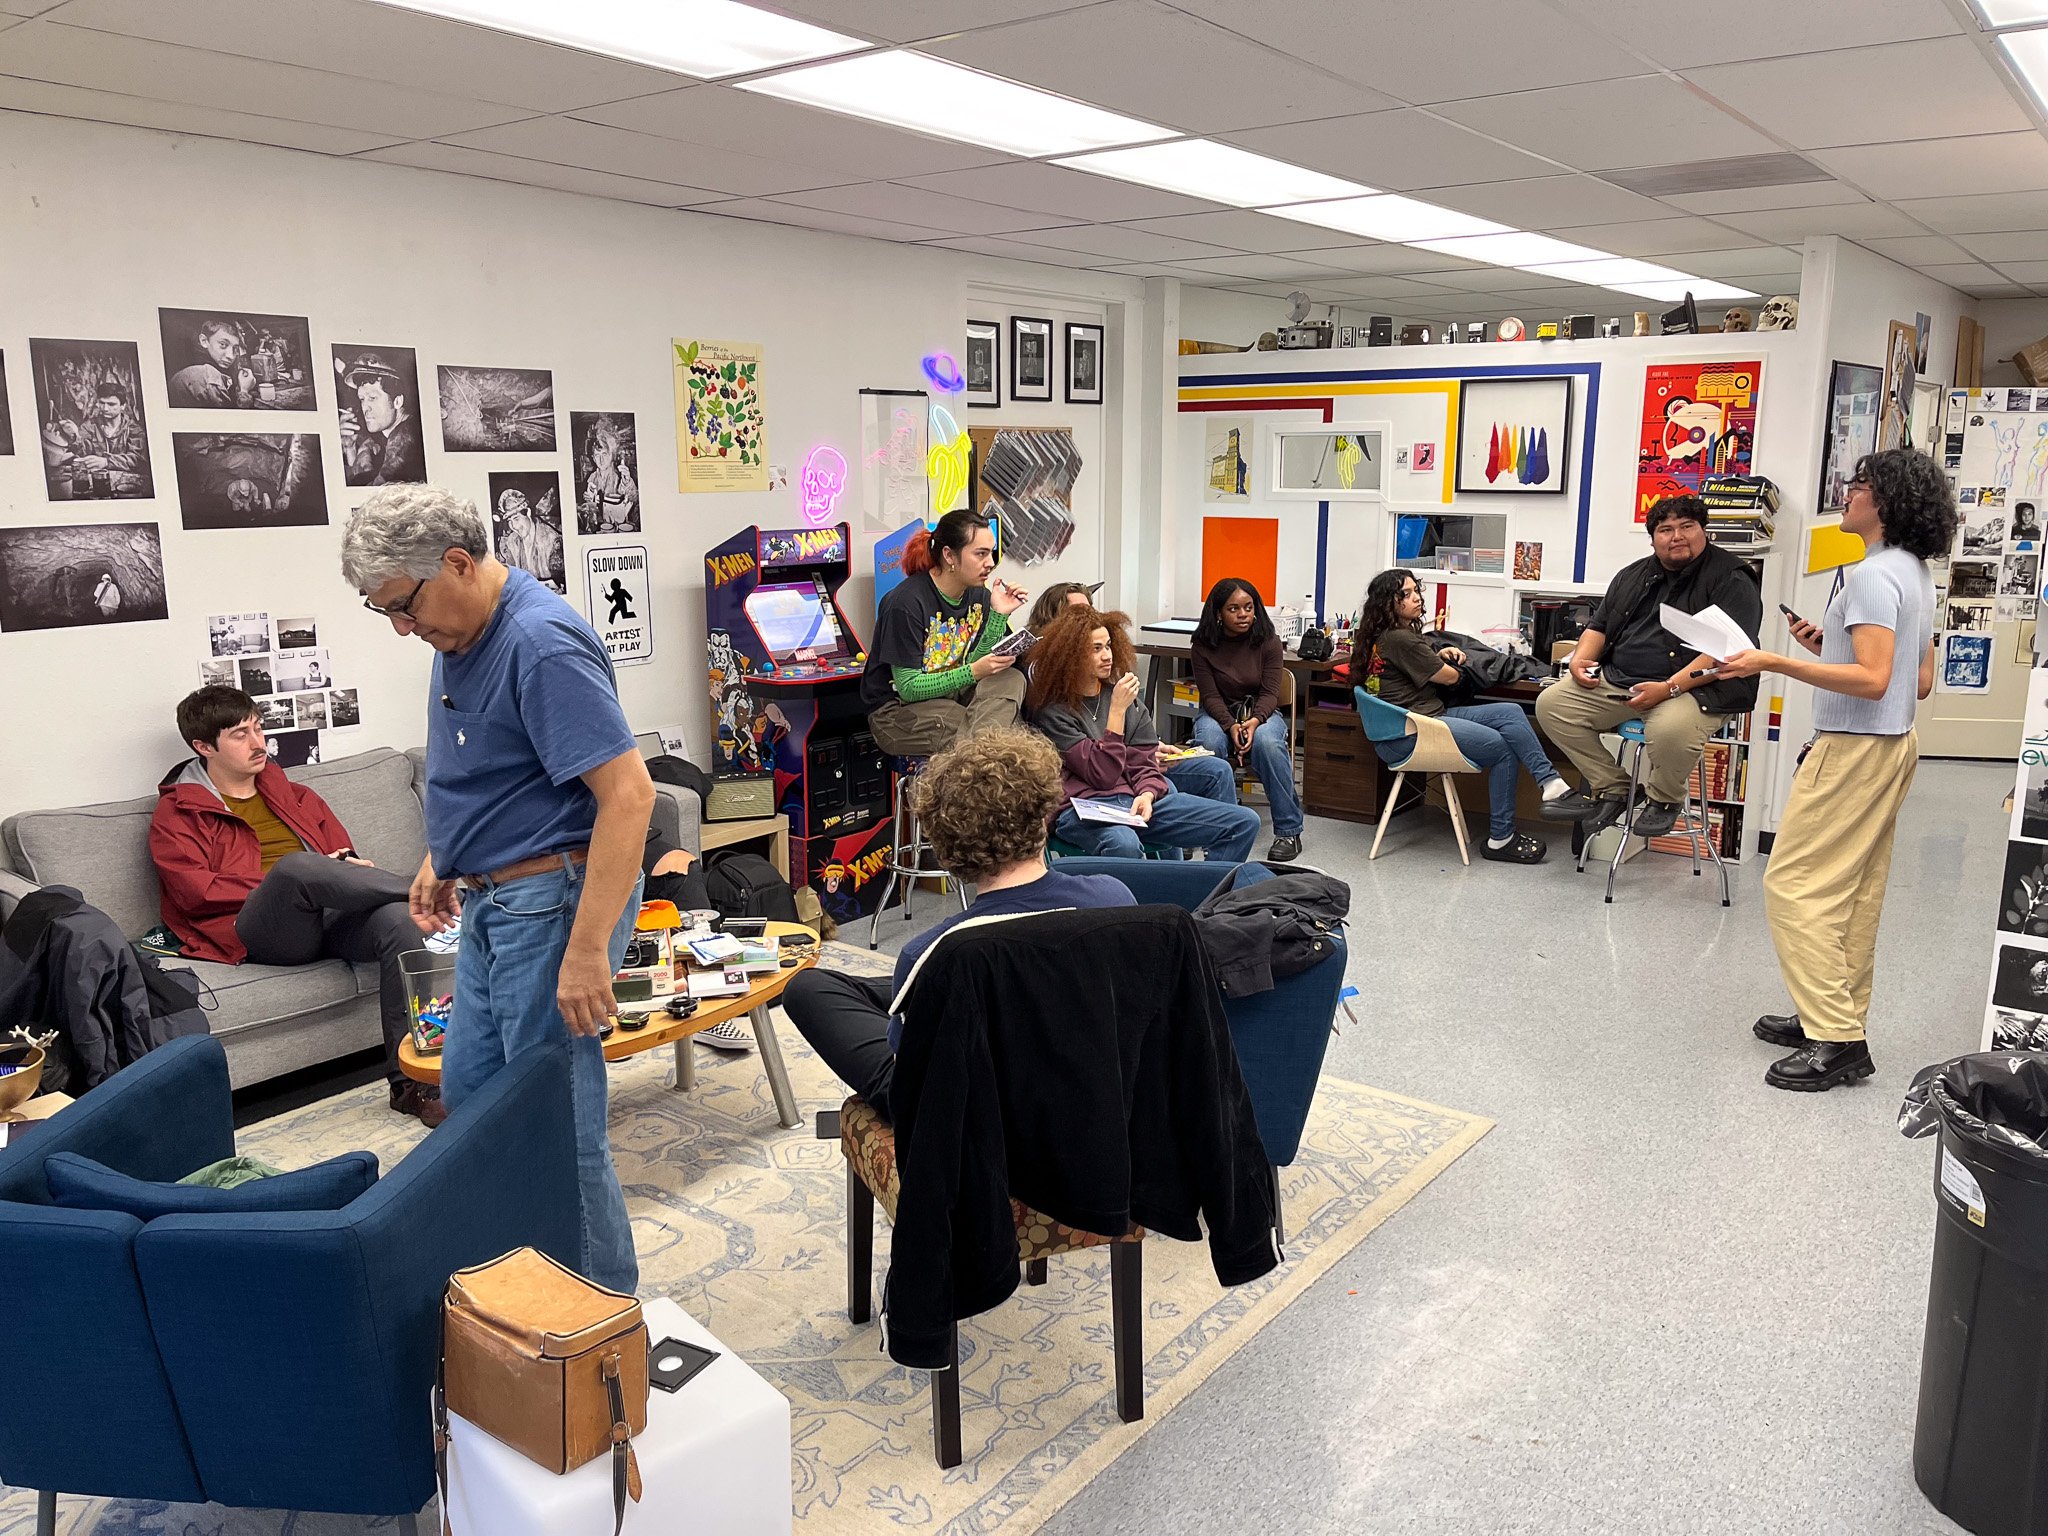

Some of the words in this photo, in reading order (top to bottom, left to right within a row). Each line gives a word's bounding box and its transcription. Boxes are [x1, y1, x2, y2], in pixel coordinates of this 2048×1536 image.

[700, 343, 719, 351] Berries
[713, 352, 729, 361] Pacific
[730, 352, 756, 361] Northwest
[1708, 483, 1737, 492] Nikon
[1703, 497, 1731, 506] Nikon
[793, 528, 842, 560] X-MEN
[592, 557, 616, 573] SLOW
[618, 555, 643, 571] DOWN
[707, 552, 756, 590] X-MEN
[605, 628, 641, 641] ARTIST
[607, 644, 616, 653] AT
[620, 642, 641, 652] PLAY
[822, 815, 842, 830] X-MEN
